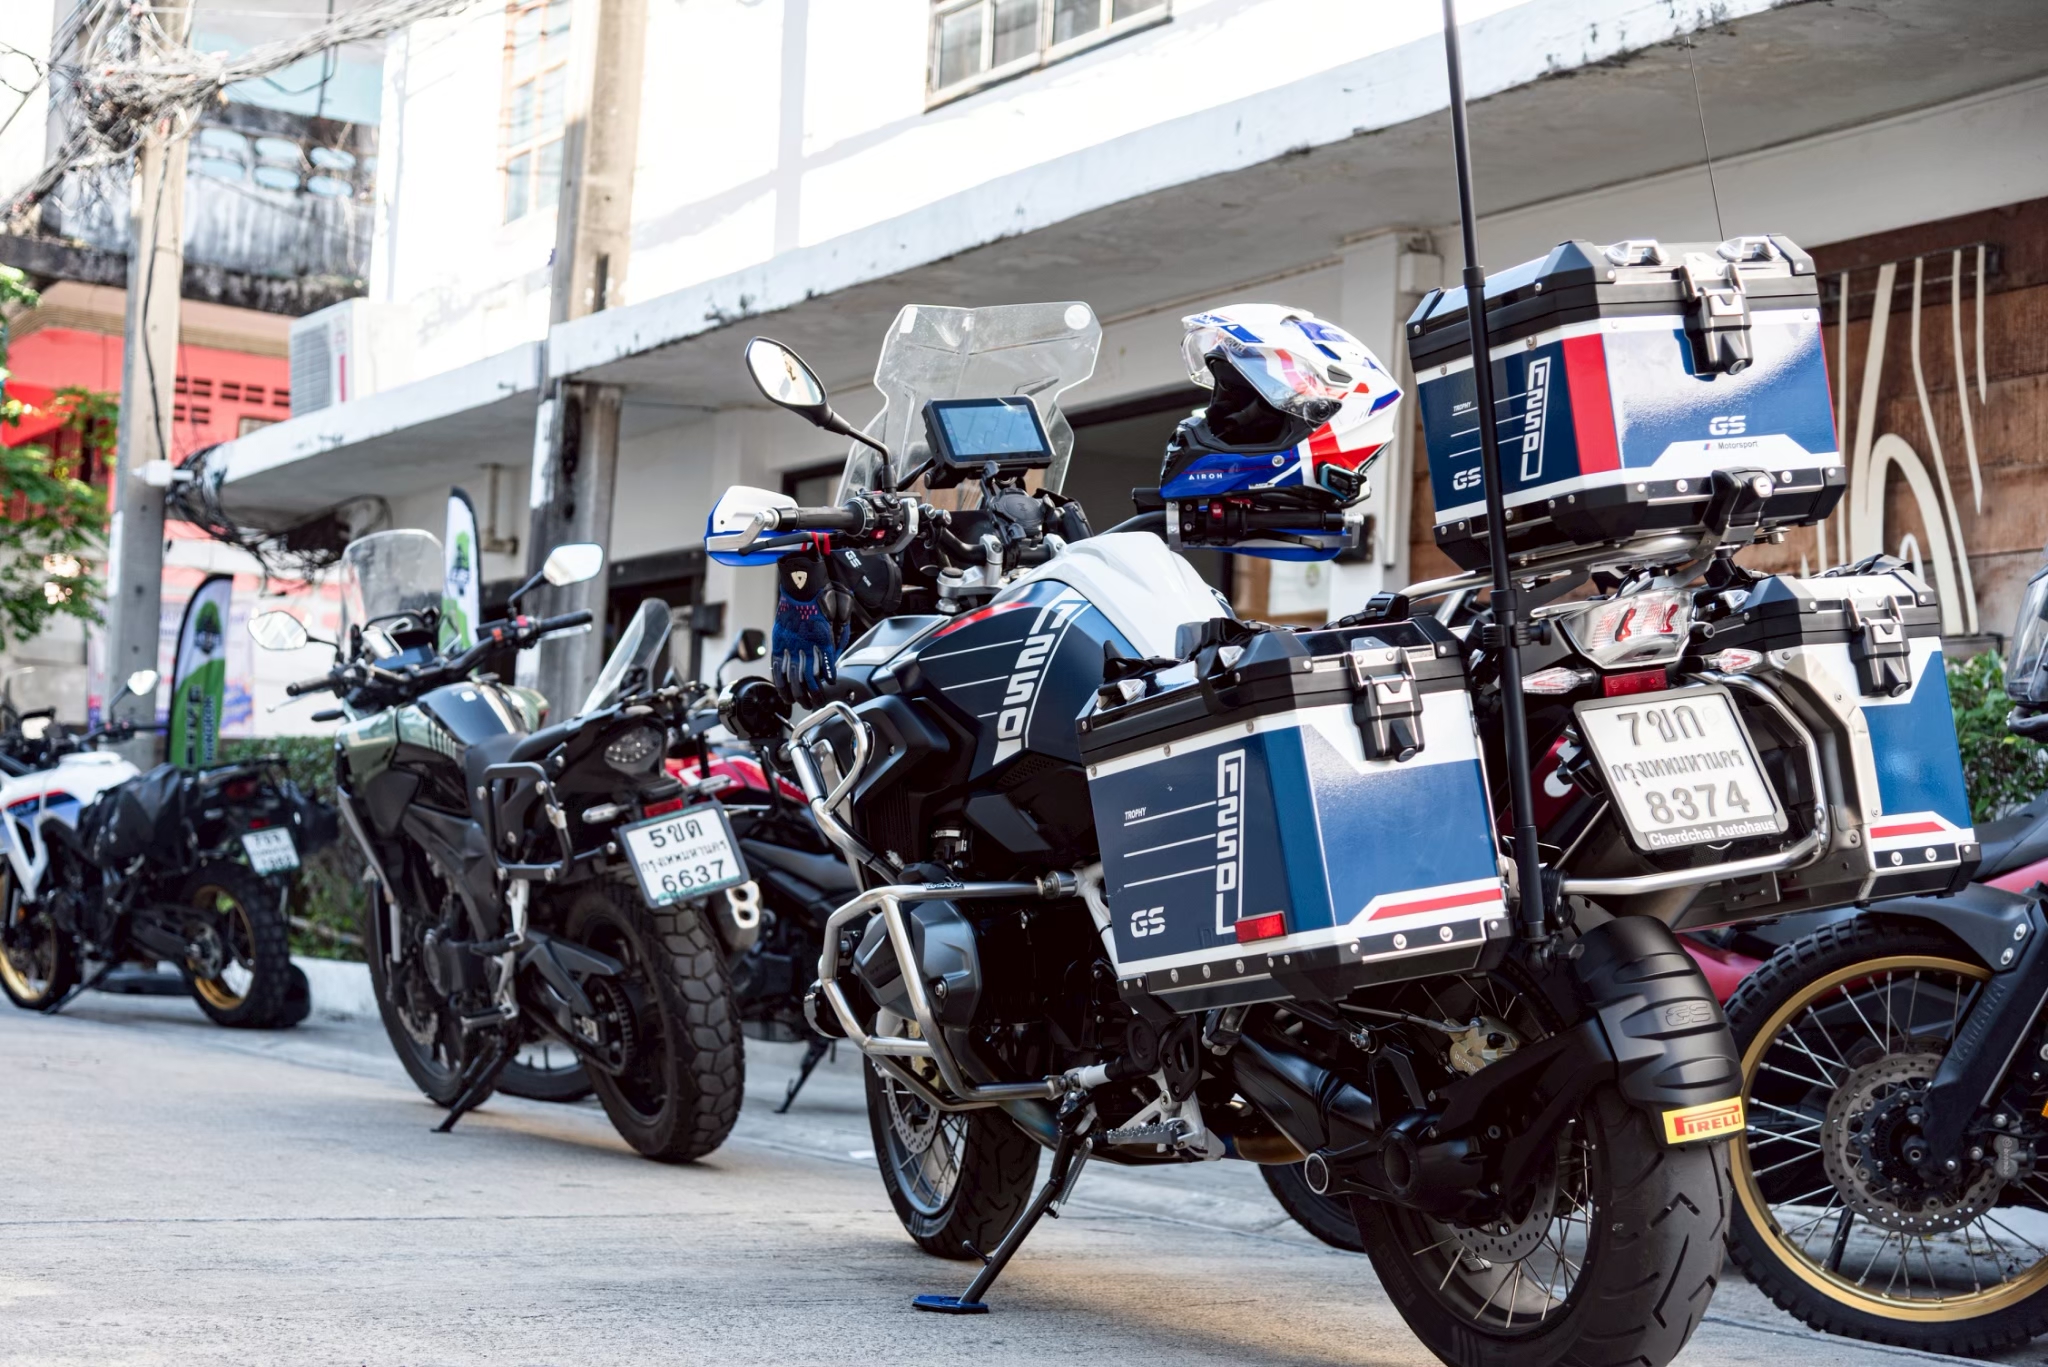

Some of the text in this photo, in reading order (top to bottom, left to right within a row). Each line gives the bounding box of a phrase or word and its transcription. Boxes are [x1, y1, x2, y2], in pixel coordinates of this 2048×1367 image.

[1709, 415, 1746, 436] GS
[1718, 441, 1759, 450] Motorsport
[1453, 466, 1482, 491] GS
[845, 550, 862, 568] GS
[1617, 706, 1706, 747] 7ขก
[1612, 749, 1745, 787] กรุงเทพมหานคร
[1124, 806, 1147, 821] TROPHY
[1645, 780, 1750, 824] 8374
[1650, 818, 1777, 846] Cherdchai Autohaus
[661, 859, 724, 894] 6637
[1131, 906, 1166, 938] GS
[1665, 1002, 1711, 1027] GS
[1951, 980, 2007, 1063] YAMAHA
[1673, 1104, 1742, 1137] PIRELLI
